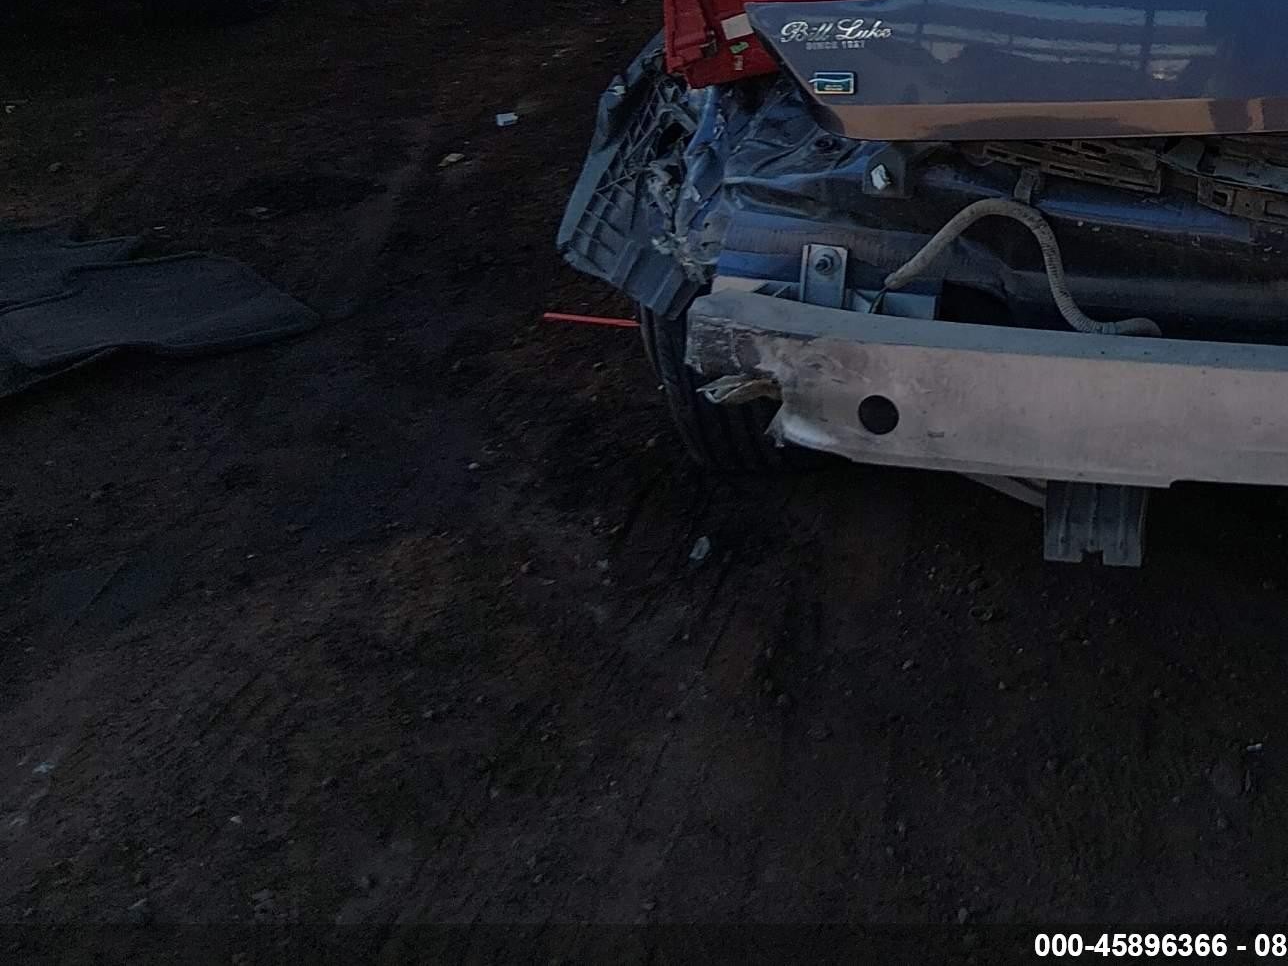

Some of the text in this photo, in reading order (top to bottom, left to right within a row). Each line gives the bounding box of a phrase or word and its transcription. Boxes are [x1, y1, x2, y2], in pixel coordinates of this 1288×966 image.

[780, 19, 893, 42] Bill Luke
[805, 41, 839, 51] SINCE
